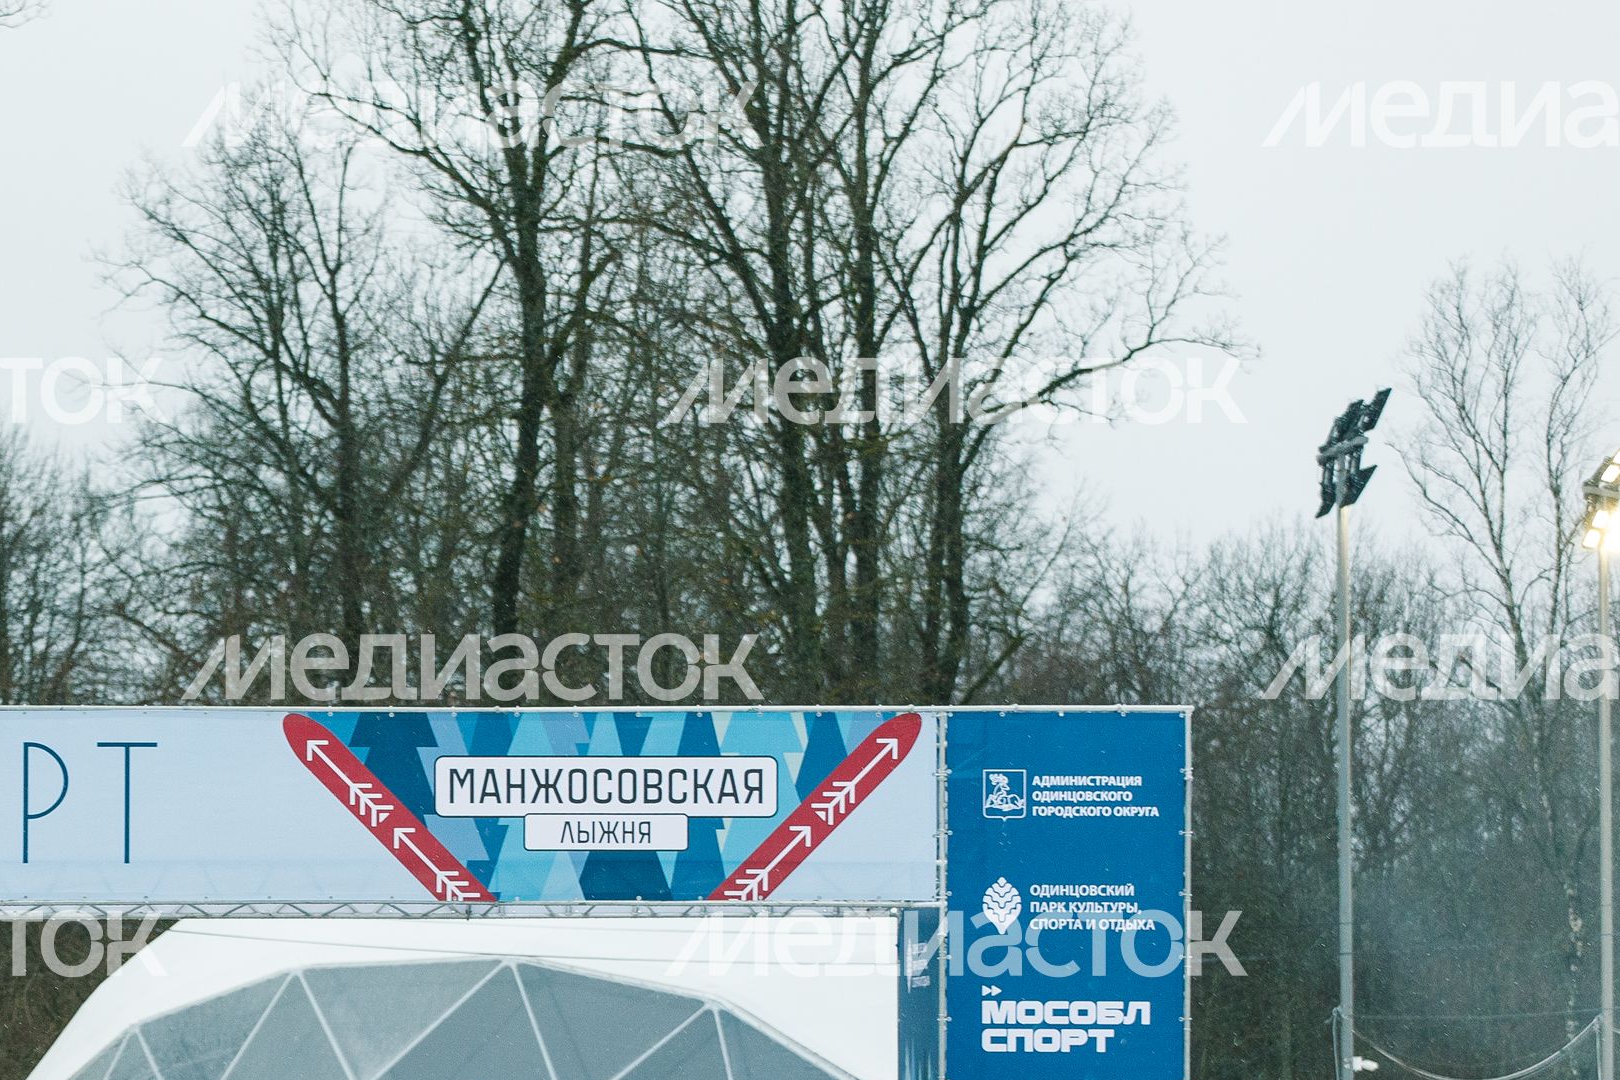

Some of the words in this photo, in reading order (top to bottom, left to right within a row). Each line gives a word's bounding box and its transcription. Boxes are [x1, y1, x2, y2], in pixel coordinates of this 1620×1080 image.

[448, 768, 765, 805] МАНЖОСОВСКАЯ
[1031, 775, 1143, 788] АДМИНИСТРАЦИЯ
[1031, 791, 1133, 803] ОДИНЦОВСКОГО
[1031, 806, 1111, 818] ГОРОДСКОГО
[1113, 806, 1160, 817] ОКРУГА
[559, 820, 653, 846] ЛЫЖНЯ
[1030, 883, 1135, 897] ОДИНЦОВСКИЙ
[1030, 901, 1066, 913] ПАРК
[1069, 901, 1142, 915] КУЛЬТУРЫ,
[1030, 918, 1082, 931] СПОРТА
[1085, 919, 1095, 930] И
[1097, 919, 1155, 932] ОТДЫХА
[981, 1000, 1151, 1025] МОСОБЛ
[981, 1029, 1115, 1053] СПОРТ
